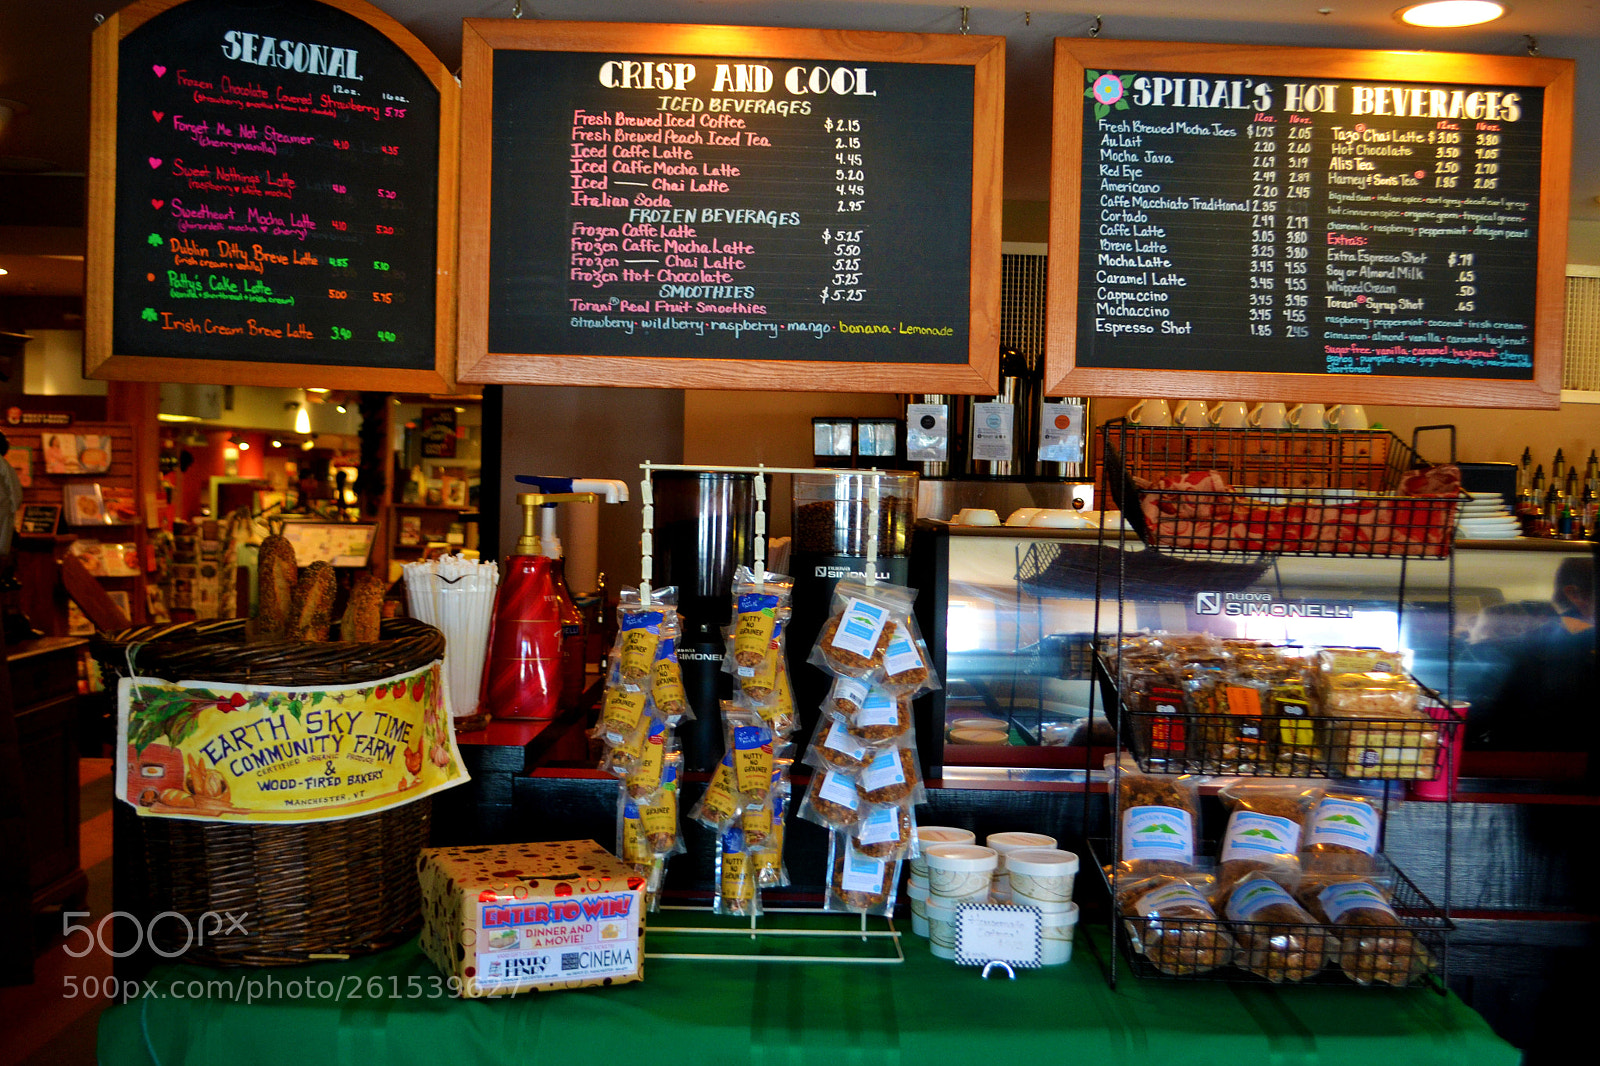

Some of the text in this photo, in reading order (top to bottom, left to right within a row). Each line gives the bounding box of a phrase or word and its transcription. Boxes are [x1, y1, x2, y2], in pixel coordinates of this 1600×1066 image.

[221, 30, 363, 81] SEASONAL
[599, 60, 877, 97] CRISP AND COOL
[176, 69, 213, 89] Frozen
[222, 76, 269, 99] Chocolate
[276, 86, 312, 105] Covered
[320, 94, 380, 121] Strawberry
[384, 107, 406, 118] 5.75
[1133, 77, 1522, 122] SPIRAL'S HOT BEVERAGES
[657, 96, 812, 116] ICED BEVERAGES
[173, 115, 208, 140] Forget
[217, 123, 232, 136] Me
[240, 125, 257, 138] Not
[265, 125, 315, 144] Steamer
[572, 126, 860, 149] Fresh Brewed Peach Iced Tea 2.15
[571, 145, 862, 165] Iced Caffe Latte 4.45
[1101, 149, 1139, 162] Mocha
[1144, 151, 1174, 164] Java
[1253, 157, 1275, 168] 2.69
[1332, 144, 1354, 155] Hot
[1356, 145, 1413, 156] Chocolate
[570, 159, 864, 181] Iced Caffe Mocha Latte 5.20
[570, 176, 864, 196] Iced Chai Latte 4.45
[1100, 178, 1160, 194] Americano
[1253, 185, 1278, 197] 2.20
[571, 191, 865, 212] Italian Soda 2.95
[1101, 195, 1276, 212] Caffe Macchiato Traditional 2.35
[171, 198, 235, 220] Sweetheart
[248, 208, 285, 227] Mocha
[291, 213, 317, 230] Latte
[629, 209, 800, 225] FROZEN BEVERAGES
[1100, 225, 1130, 236] Caffe
[1134, 226, 1166, 237] Latte
[1100, 239, 1133, 251] Breve
[1135, 240, 1168, 253] Latte
[571, 254, 861, 272] Frozen Chai Latte 5.25
[1327, 248, 1356, 262] Extra
[1357, 250, 1400, 264] Espresso
[1402, 252, 1427, 264] Shot
[167, 270, 203, 291] Patty's
[209, 275, 237, 292] Cake
[244, 279, 272, 295] Latte
[571, 269, 862, 288] Frozen Hot Chocolate 5.25
[1096, 270, 1147, 286] Caramel
[1152, 272, 1187, 286] Latte
[1326, 265, 1346, 281] Soy
[1346, 269, 1357, 277] or
[1359, 267, 1395, 279] Almond
[1397, 268, 1423, 279] Milk
[659, 285, 755, 298] SMOOTHIES
[1326, 282, 1363, 296] Whipped
[1364, 283, 1397, 294] Cream
[161, 311, 201, 333] Irish
[204, 319, 243, 335] Cream
[247, 319, 283, 338] Breve
[287, 323, 314, 339] Latte
[1096, 319, 1154, 336] Espresso
[1161, 321, 1192, 335] Shot
[1225, 592, 1271, 600] nuova
[1225, 602, 1354, 618] SIMONELLI
[200, 709, 413, 766] EARTH SKY TIME
[229, 735, 397, 778] COMMUNITY FARM
[324, 761, 336, 776] &
[257, 769, 383, 792] WOOD-FIRED BAKERY
[482, 894, 633, 928] ENTER TO WIN!
[526, 925, 592, 938] DINNER AND
[545, 935, 584, 946] MOVIE!
[505, 956, 551, 968] BISTRO
[579, 950, 633, 969] CINEMA
